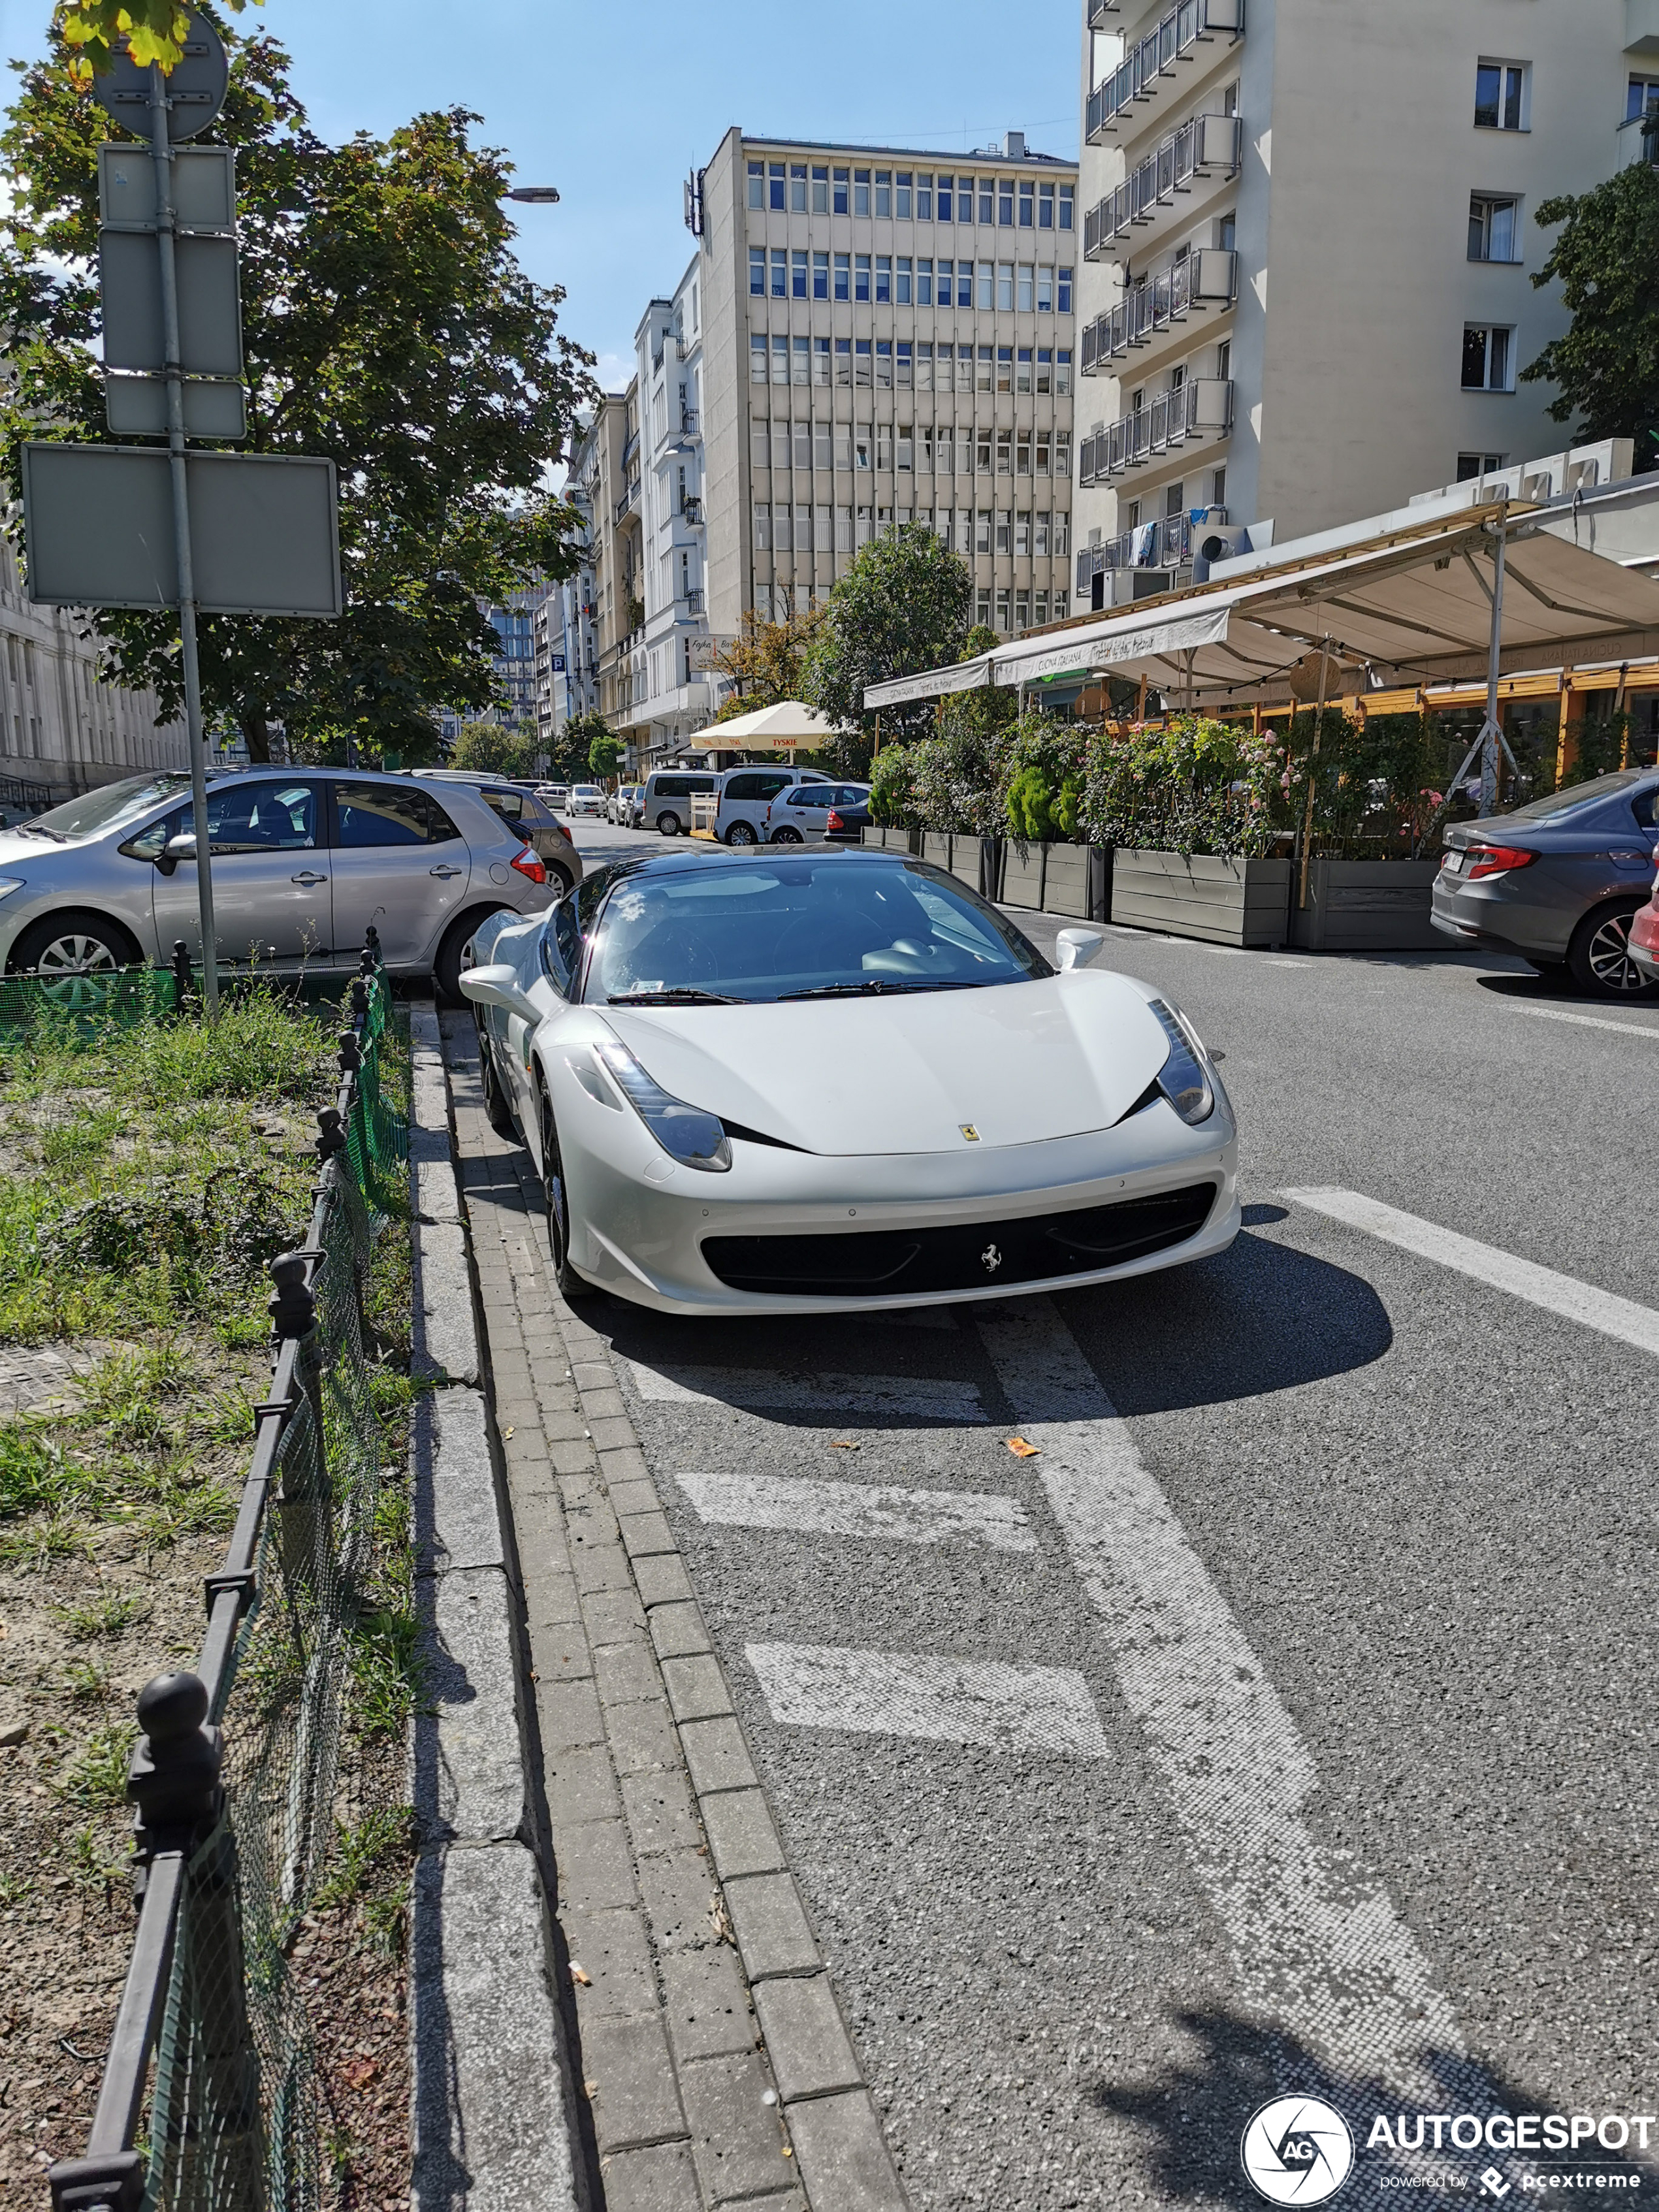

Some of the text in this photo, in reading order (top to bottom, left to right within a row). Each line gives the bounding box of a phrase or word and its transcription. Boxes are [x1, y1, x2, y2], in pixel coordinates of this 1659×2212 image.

[692, 640, 711, 652] Fajka
[1039, 658, 1057, 671] CUCINA
[1057, 652, 1082, 667] ITALIANA
[1119, 641, 1129, 654] da
[555, 660, 562, 670] P
